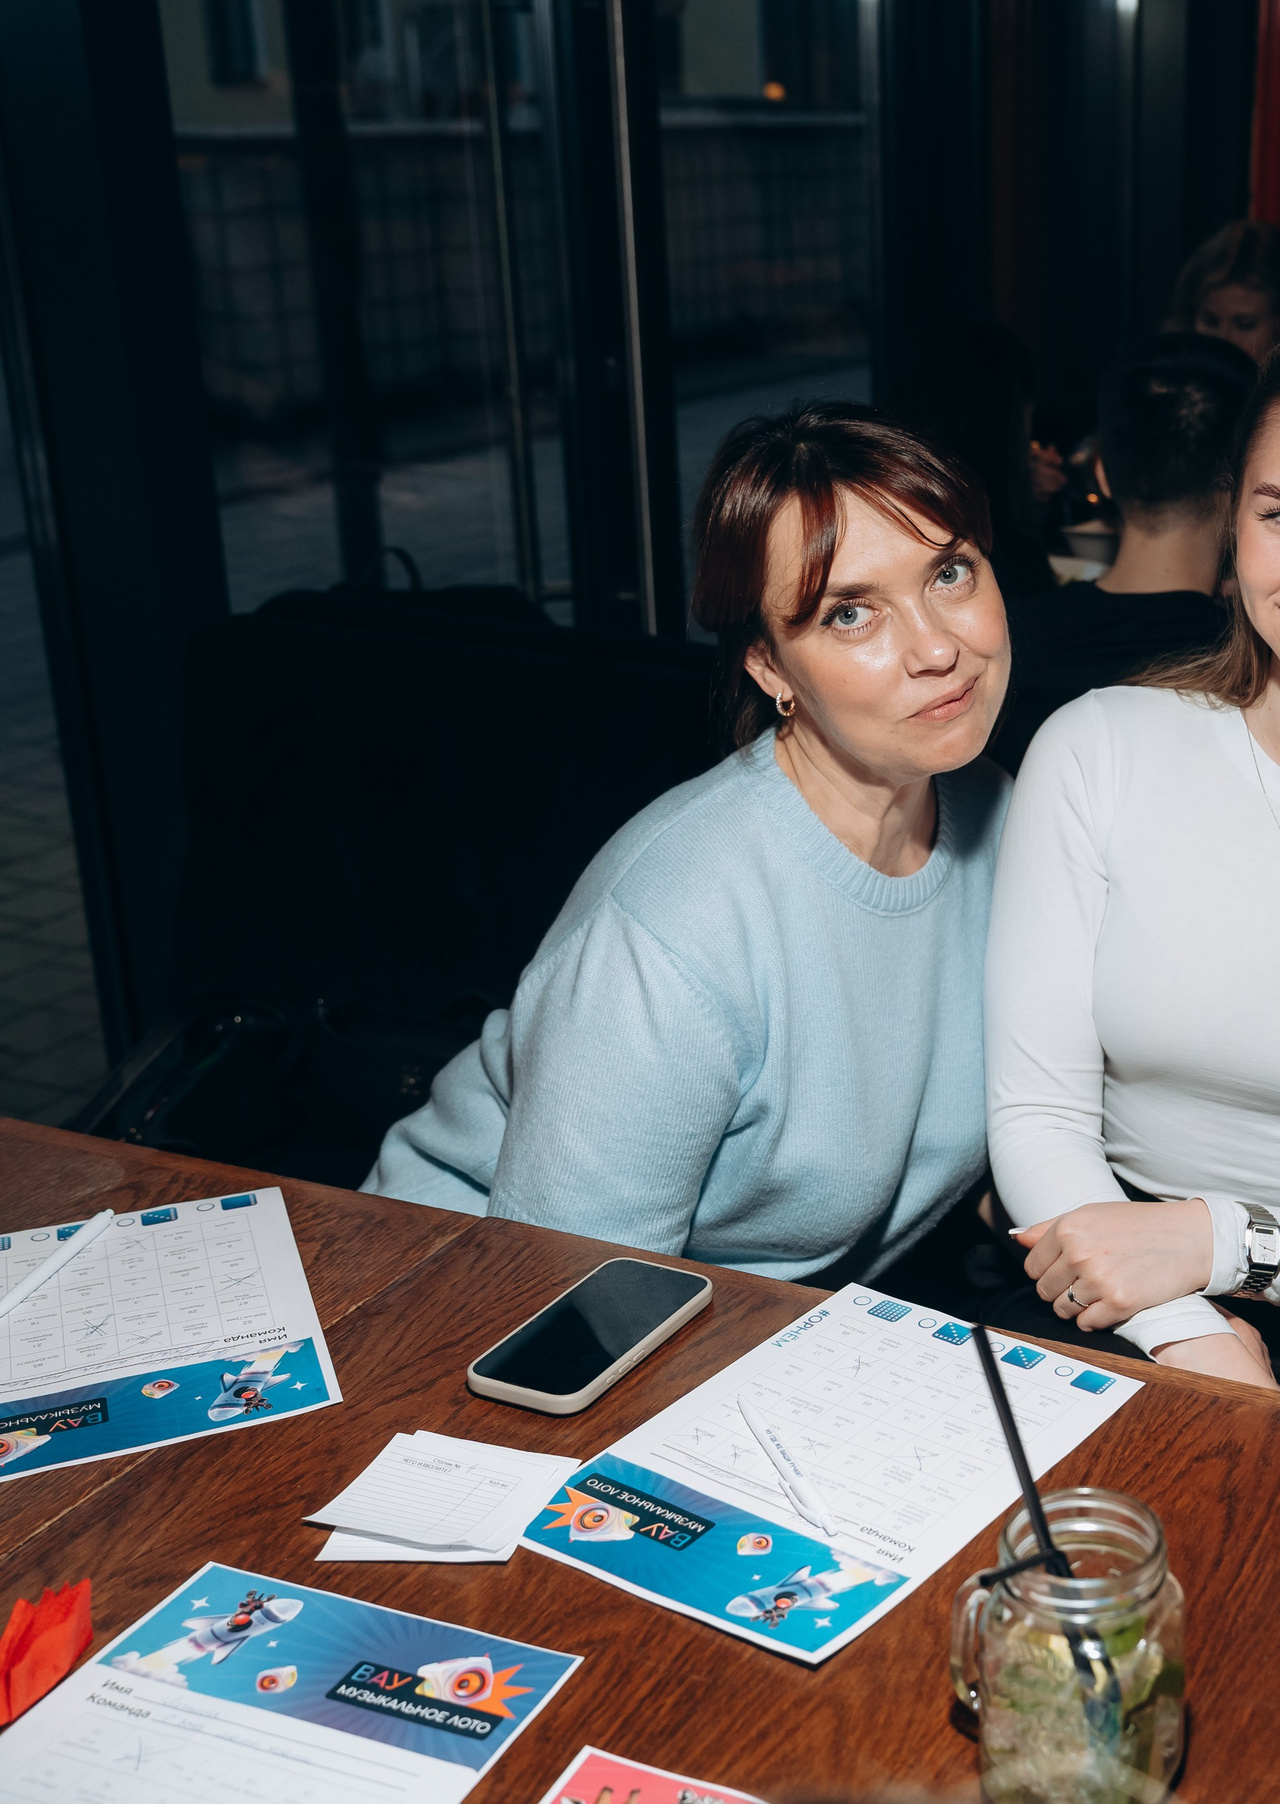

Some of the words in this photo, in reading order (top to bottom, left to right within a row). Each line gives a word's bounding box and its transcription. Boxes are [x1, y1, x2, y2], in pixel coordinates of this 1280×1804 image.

[224, 1327, 285, 1342] Команда
[259, 1334, 287, 1343] Имя
[771, 1309, 831, 1347] #ОРНЁМ
[49, 1411, 102, 1432] ВАУ
[417, 1461, 452, 1474] ИЗВОЛИТЕ?
[586, 1478, 621, 1497] ЛОТО
[617, 1490, 706, 1533] МУЗЫКАЛЬНОЕ
[640, 1522, 692, 1548] ВАУ
[860, 1527, 914, 1552] Команда
[877, 1548, 903, 1562] Имя
[102, 1679, 134, 1697] Имя
[351, 1664, 413, 1691] ВАУ
[87, 1692, 151, 1720] Команда
[336, 1684, 450, 1724] МУЗЫКАЛЬНОЕ
[446, 1713, 492, 1735] ЛОТО
